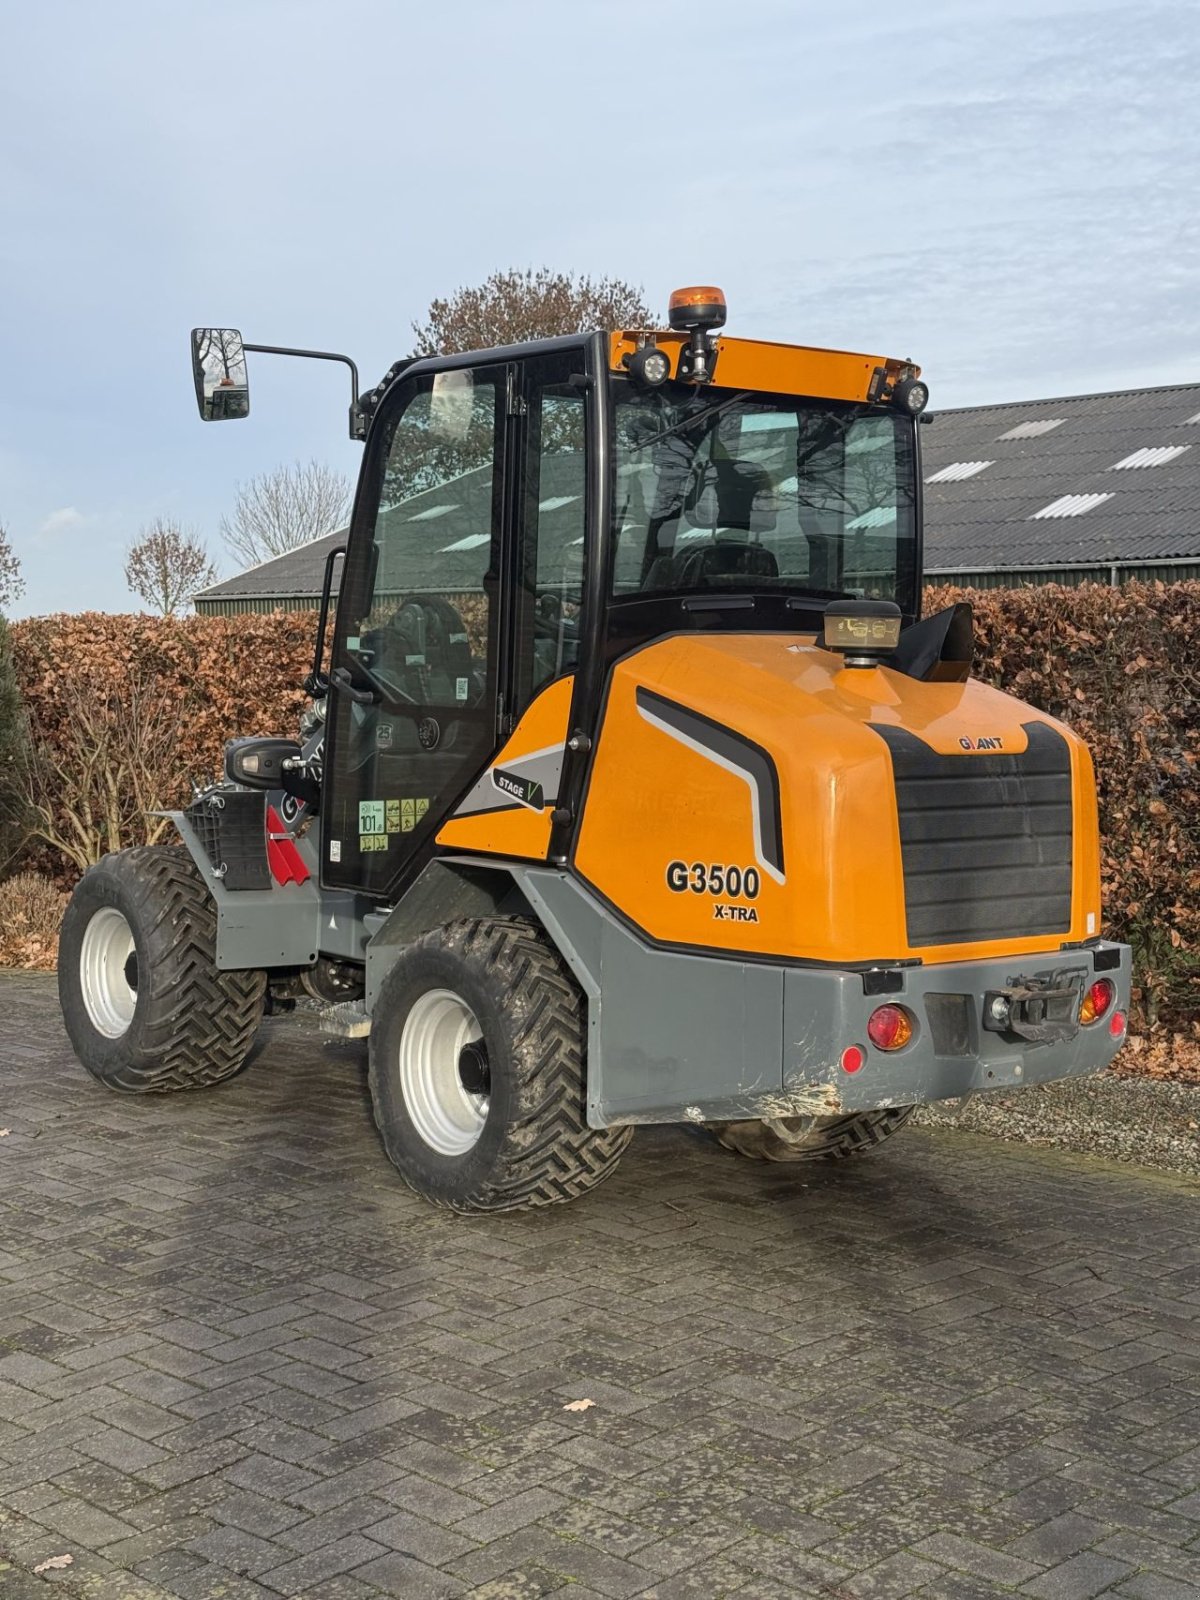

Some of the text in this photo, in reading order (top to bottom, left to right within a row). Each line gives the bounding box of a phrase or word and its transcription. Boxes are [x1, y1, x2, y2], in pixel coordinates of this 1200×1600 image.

[378, 727, 390, 739] 25
[959, 736, 1003, 750] GIANT
[499, 777, 540, 802] STAGE V
[361, 815, 376, 832] 101
[667, 861, 760, 900] G3500
[714, 904, 759, 923] X-TRA
